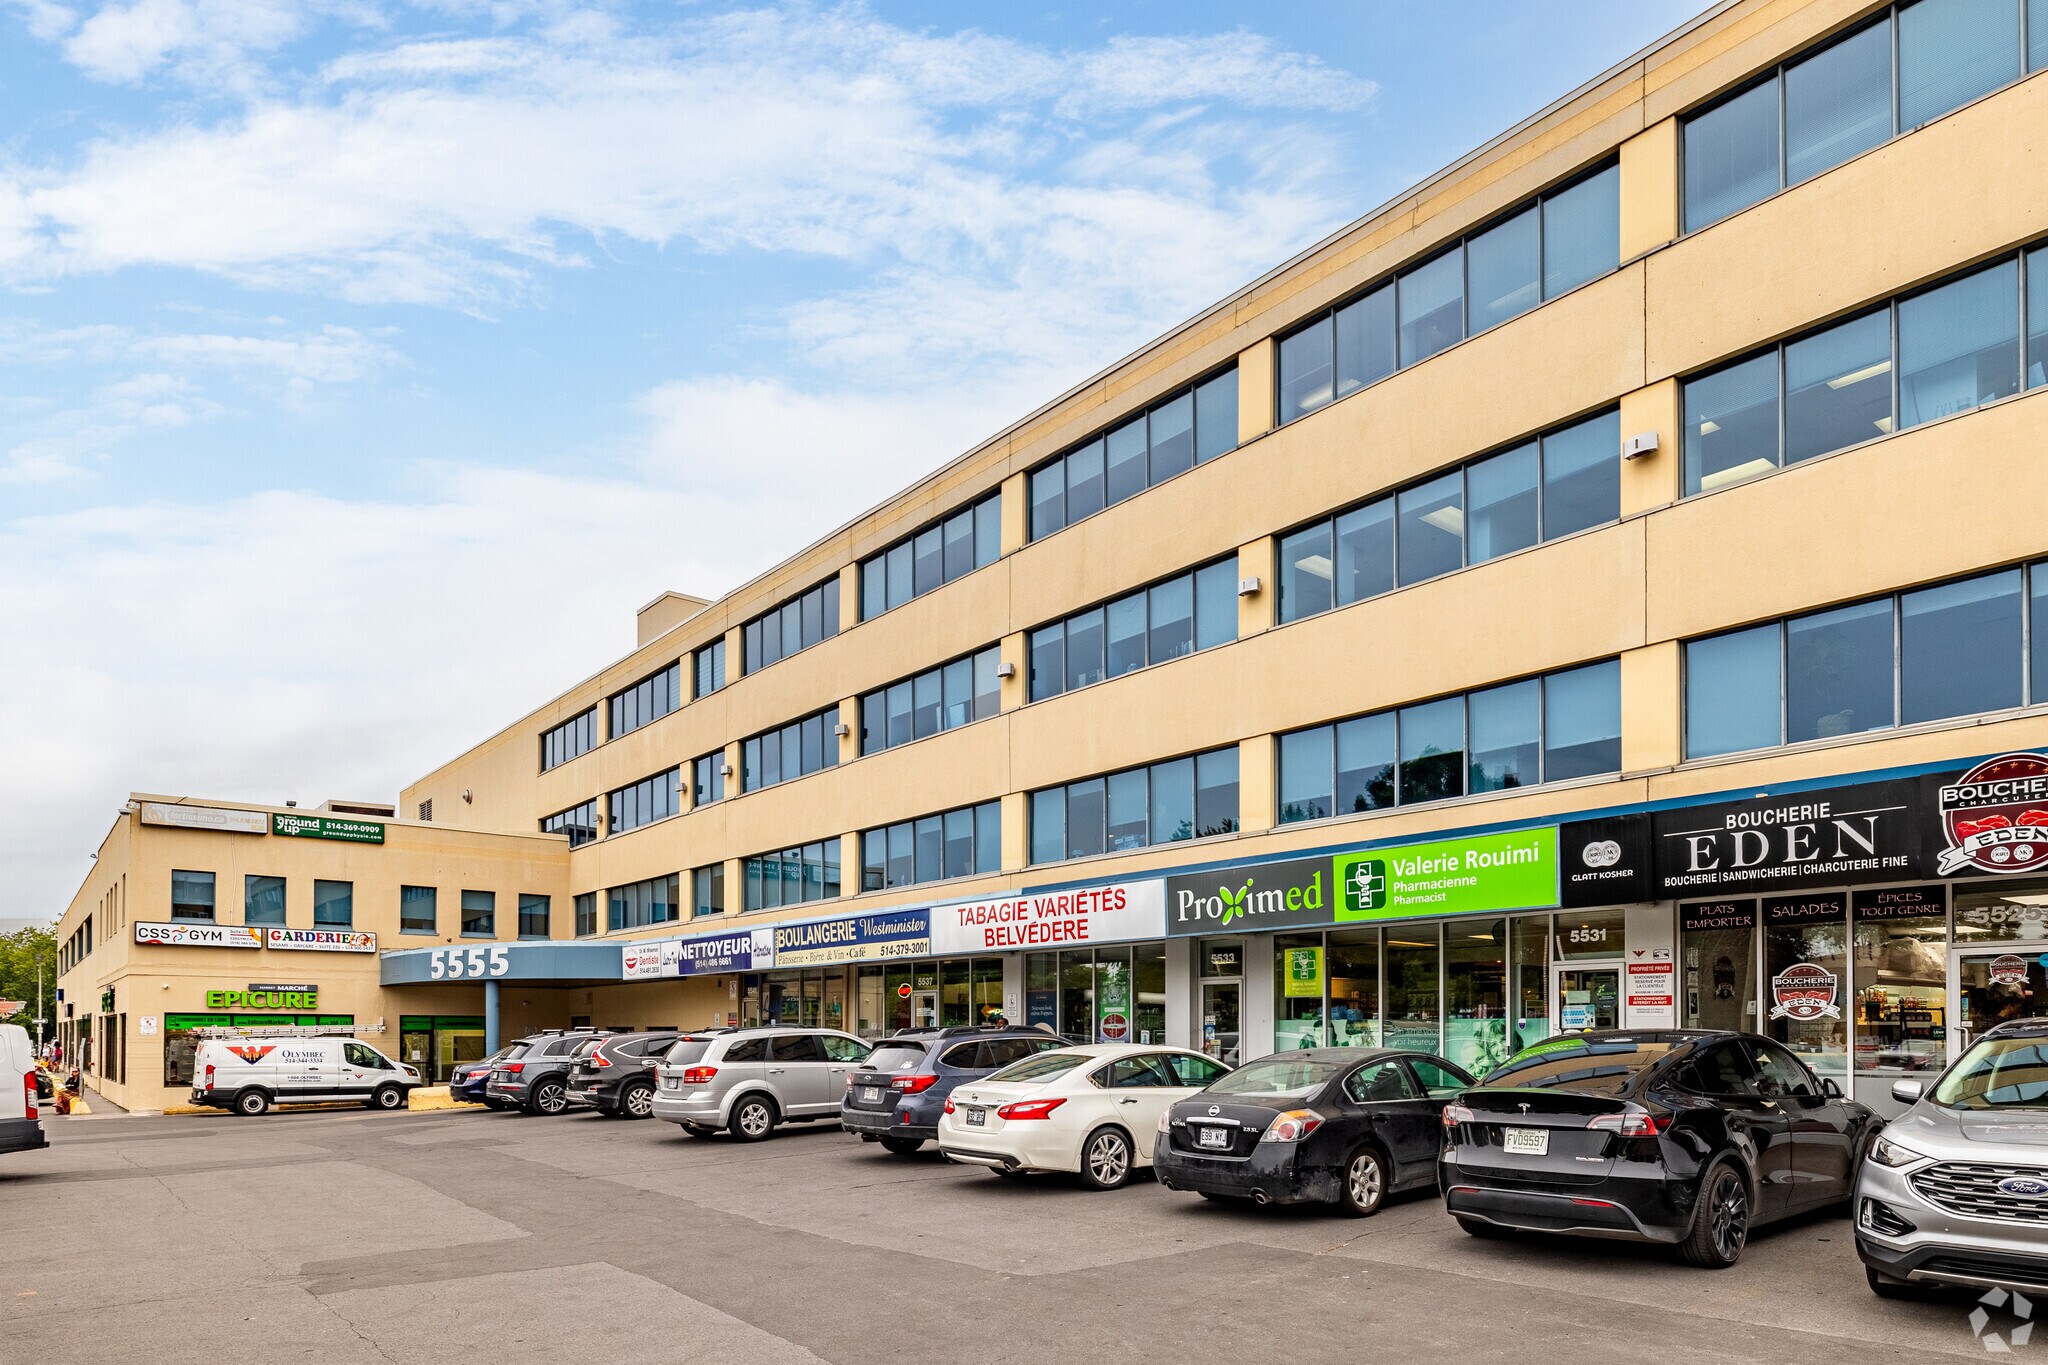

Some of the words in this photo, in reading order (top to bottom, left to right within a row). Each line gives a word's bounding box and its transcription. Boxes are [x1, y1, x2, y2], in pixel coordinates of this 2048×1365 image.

[1959, 793, 2048, 806] CHARCUTE
[1726, 802, 1830, 830] BOUCHERIE
[276, 816, 320, 830] ground
[326, 822, 380, 833] 514-369-0909
[284, 826, 300, 835] up
[1686, 816, 1879, 872] EDEN
[1393, 855, 1459, 877] Valerie
[1465, 841, 1539, 869] Rouimi
[1571, 872, 1598, 881] GLATT
[1599, 869, 1634, 879] KOSHER
[1664, 872, 1717, 887] BOUCHERIE
[1722, 866, 1798, 881] SANDWICHERIE
[1803, 858, 1879, 875] CHARCUTERIE
[1882, 855, 1908, 868] FINE
[1393, 873, 1477, 893] Pharmacienne
[1393, 890, 1446, 906] Pharmacist
[1878, 892, 1922, 903] ÉPICES
[958, 901, 1028, 926] TABAGIE
[1034, 887, 1127, 919] VARIÉTÉS
[1700, 904, 1735, 915] PLATS
[1771, 902, 1839, 918] SALADES
[1860, 907, 1895, 916] TOUT
[1898, 904, 1940, 915] GENRE
[1975, 904, 2041, 923] 5525
[1686, 916, 1752, 929] EMPORTER
[138, 927, 170, 939] CSS
[189, 930, 222, 941] GYM
[270, 931, 351, 943] GARDERIE
[779, 919, 857, 948] BOULANGERIE
[860, 917, 927, 936] Westminister
[984, 918, 1088, 947] BELVÉDERE
[1570, 929, 1606, 942] 5531
[679, 937, 751, 960] NETTOYEUR
[849, 946, 866, 958] Café
[880, 941, 928, 956] 514-379-3001
[430, 948, 509, 979] 5555
[695, 960, 708, 969] (514)
[1210, 953, 1235, 964] 5533
[917, 977, 933, 986] 5537
[1775, 977, 1834, 985] BOUCHERIE
[207, 990, 318, 1009] EPICURE
[1788, 998, 1822, 1006] EDEN
[1407, 1037, 1437, 1046] heureux
[282, 1049, 326, 1058] OLYMBEC
[1507, 1134, 1546, 1147] FVD9597
[2011, 1181, 2040, 1193] Ford
